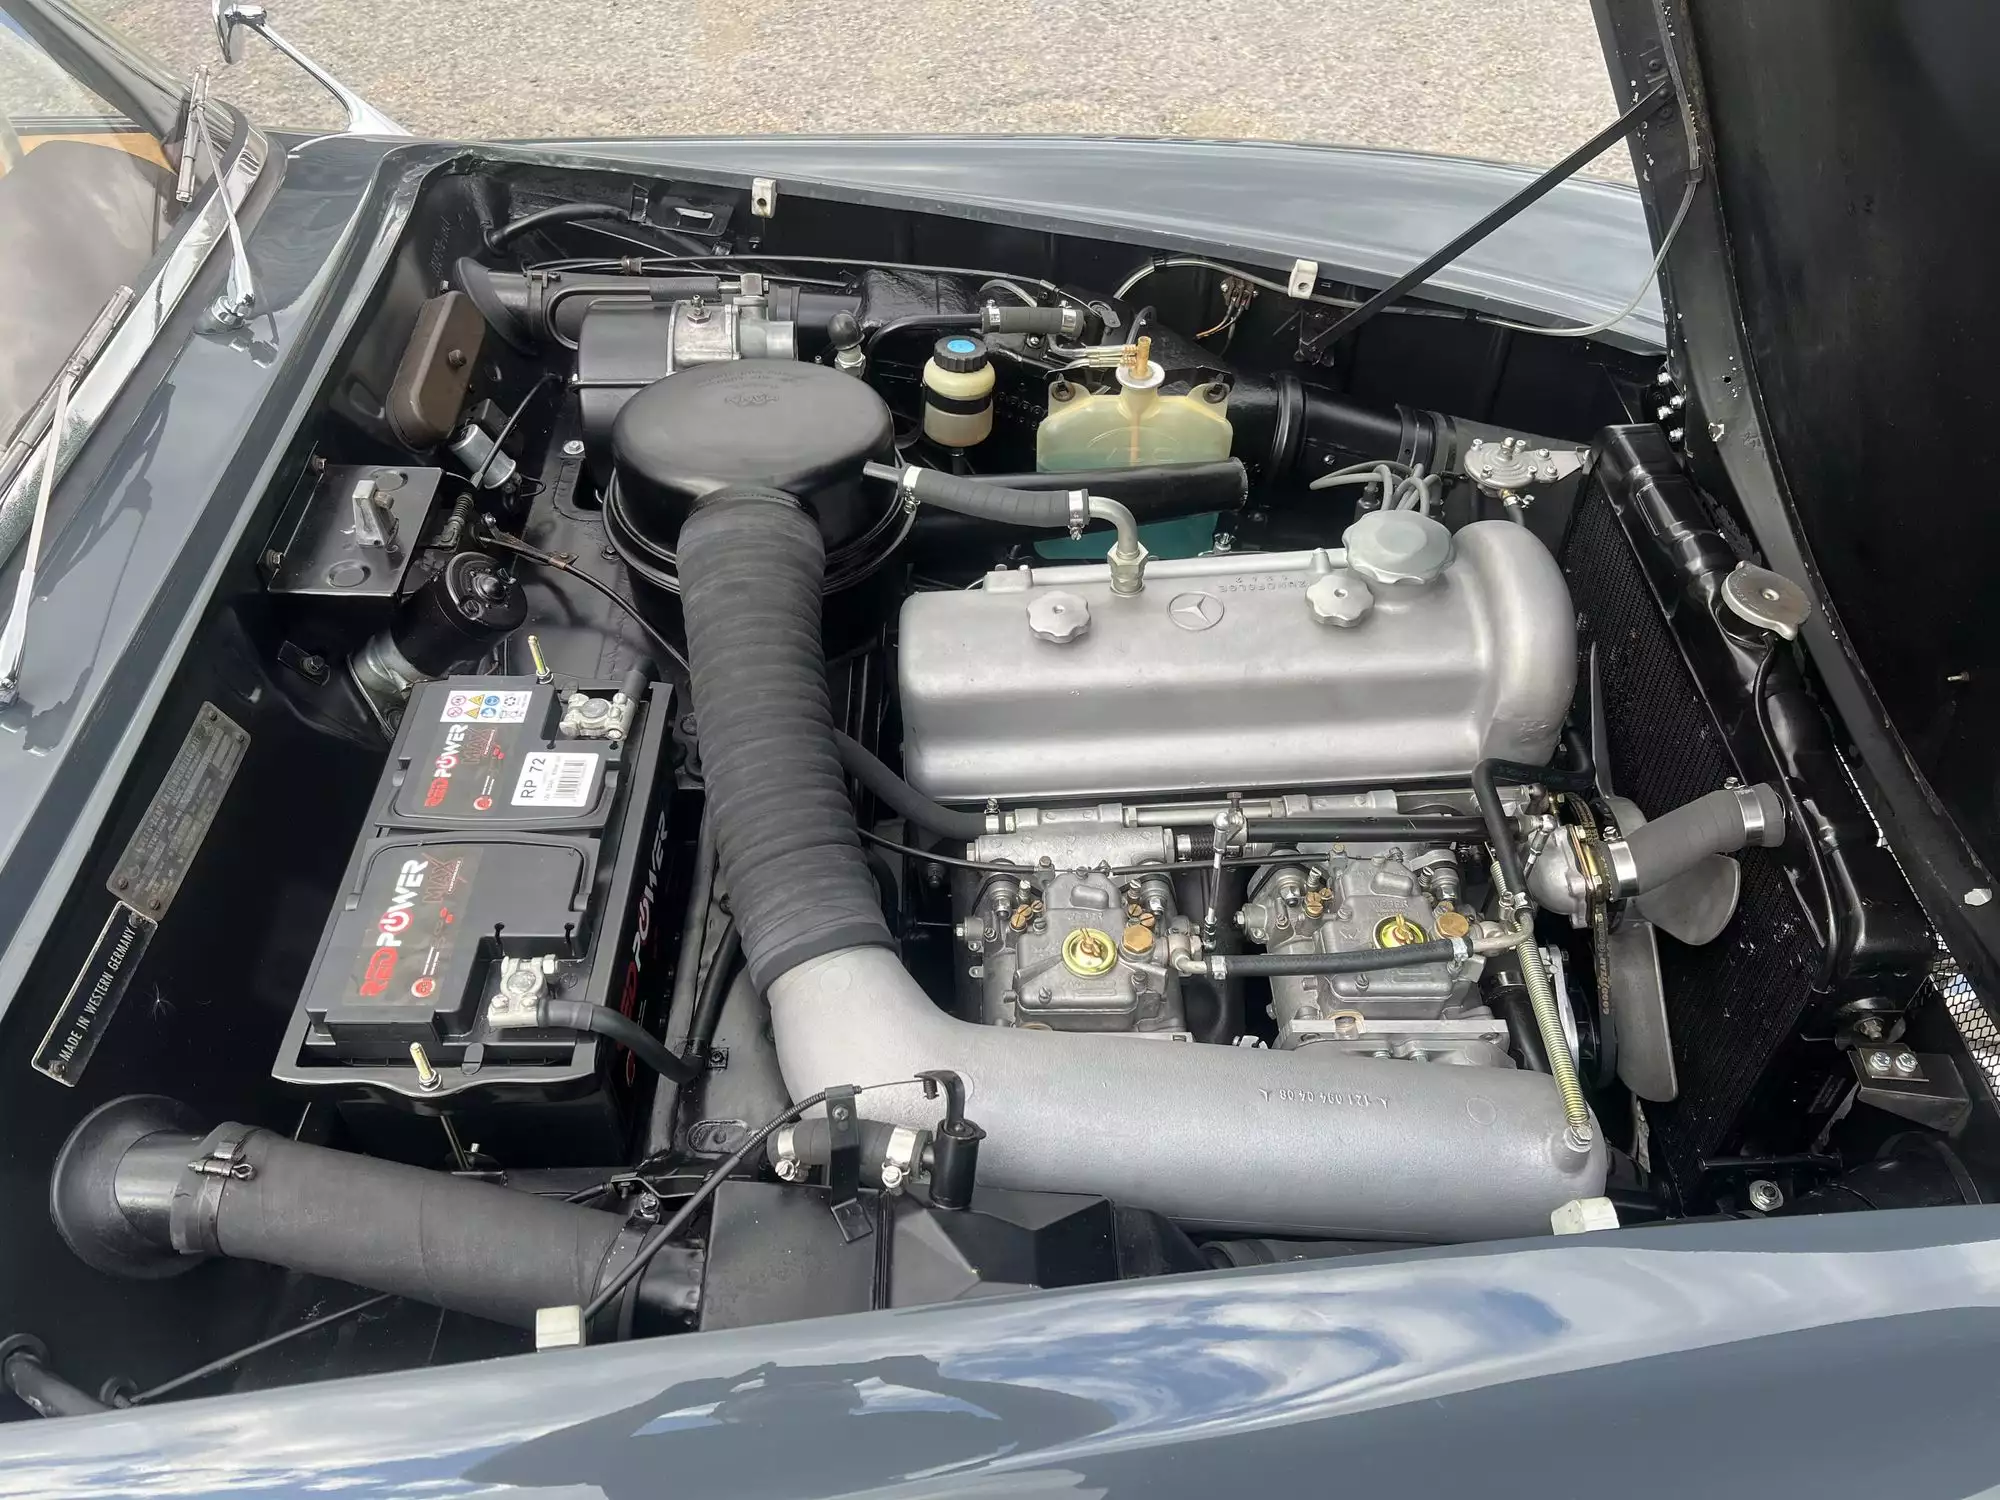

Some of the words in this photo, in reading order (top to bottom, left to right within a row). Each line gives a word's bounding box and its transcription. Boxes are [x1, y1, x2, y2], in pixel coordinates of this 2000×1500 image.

[521, 779, 537, 798] RP
[529, 757, 546, 773] 72
[421, 852, 468, 904] MAX
[59, 1030, 83, 1061] MADE
[76, 1015, 91, 1031] IN
[84, 971, 115, 1015] WESTERN
[107, 926, 136, 972] GERMANY
